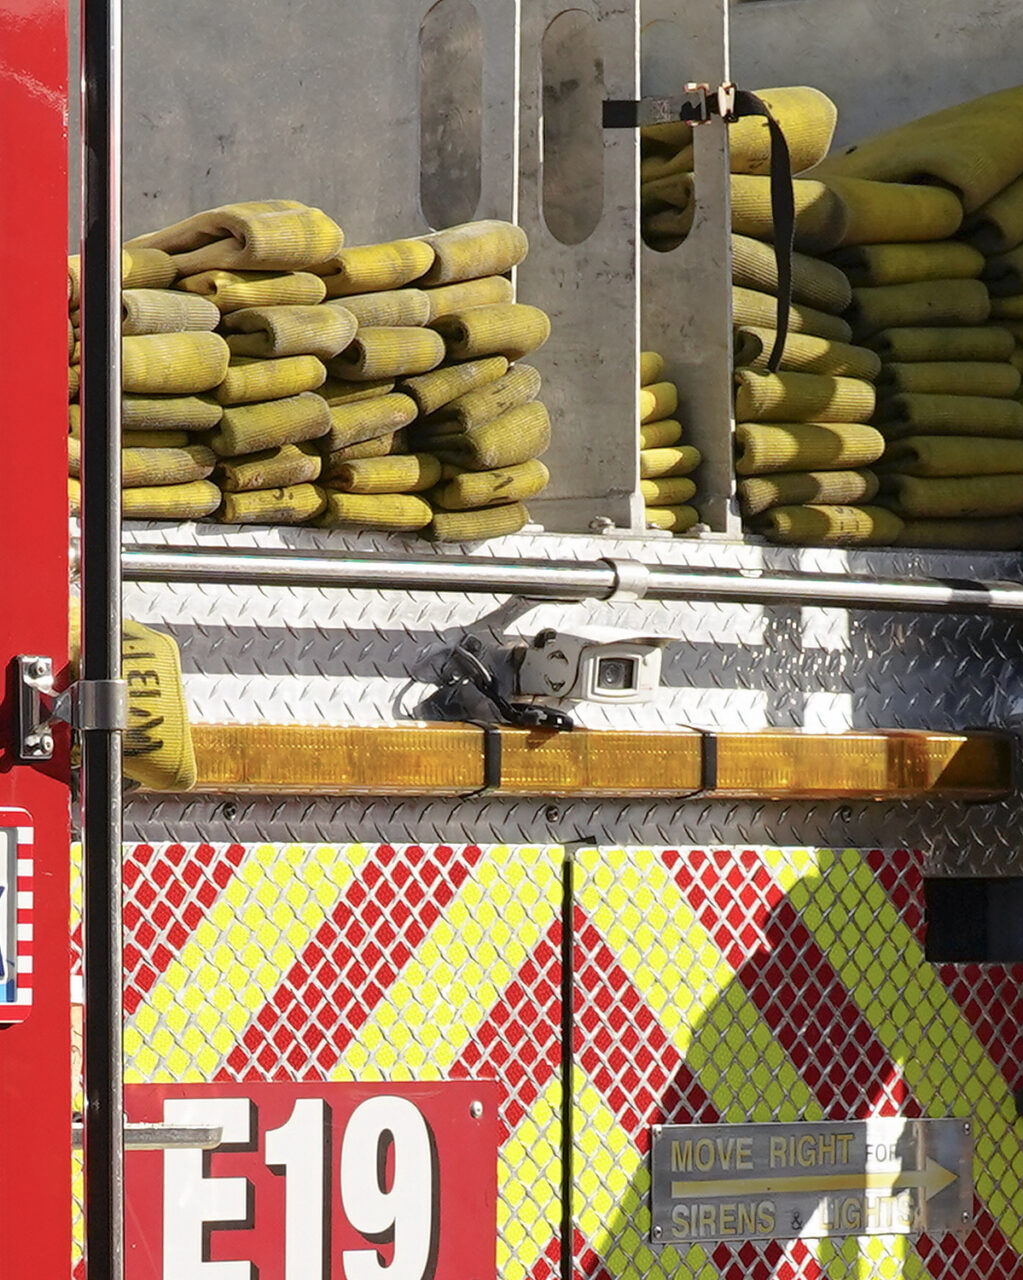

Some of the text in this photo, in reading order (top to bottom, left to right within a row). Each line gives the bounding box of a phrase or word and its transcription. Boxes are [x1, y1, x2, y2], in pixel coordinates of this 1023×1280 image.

[671, 1136, 754, 1172] MOVE
[769, 1132, 855, 1169] RIGHT
[671, 1196, 915, 1239] SIRENS & LIGHTS
